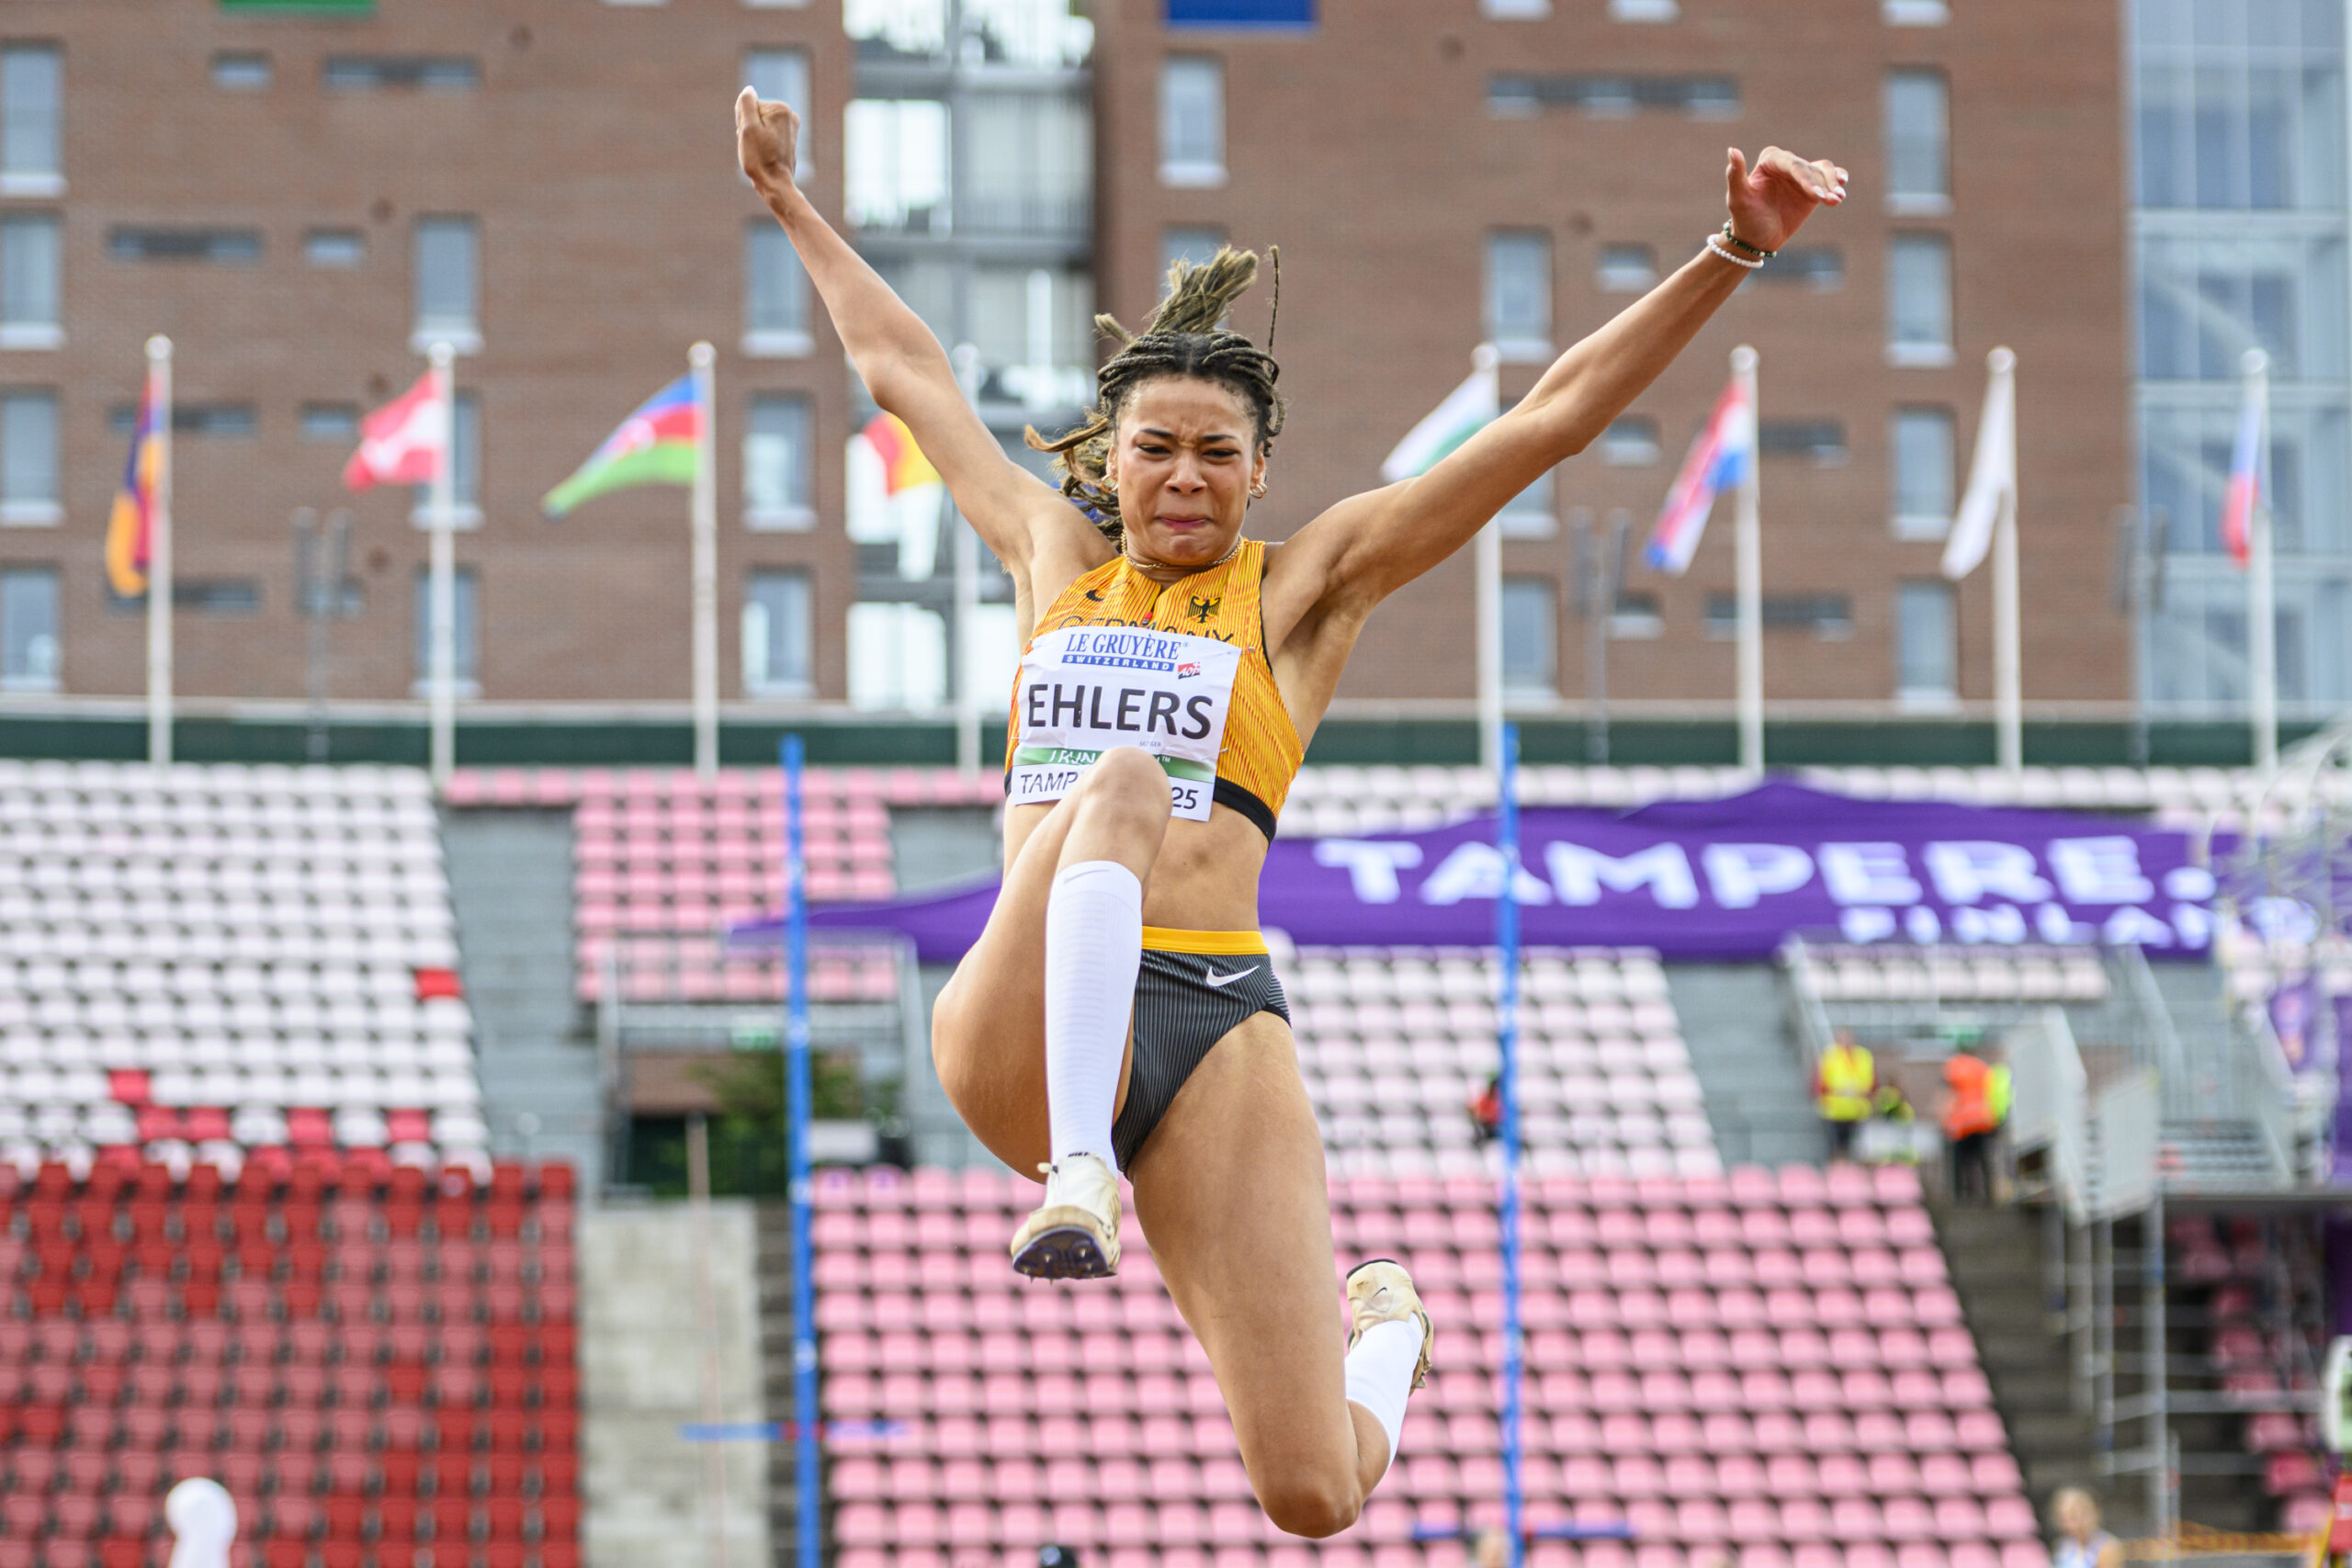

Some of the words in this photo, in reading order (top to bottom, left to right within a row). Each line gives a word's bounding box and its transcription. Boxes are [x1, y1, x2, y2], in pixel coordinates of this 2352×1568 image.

[1066, 633, 1091, 653] LE
[1066, 654, 1170, 671] SWITZERLAND
[1028, 683, 1214, 740] EHLERS
[1020, 772, 1079, 795] TAMP
[1171, 786, 1199, 810] 25
